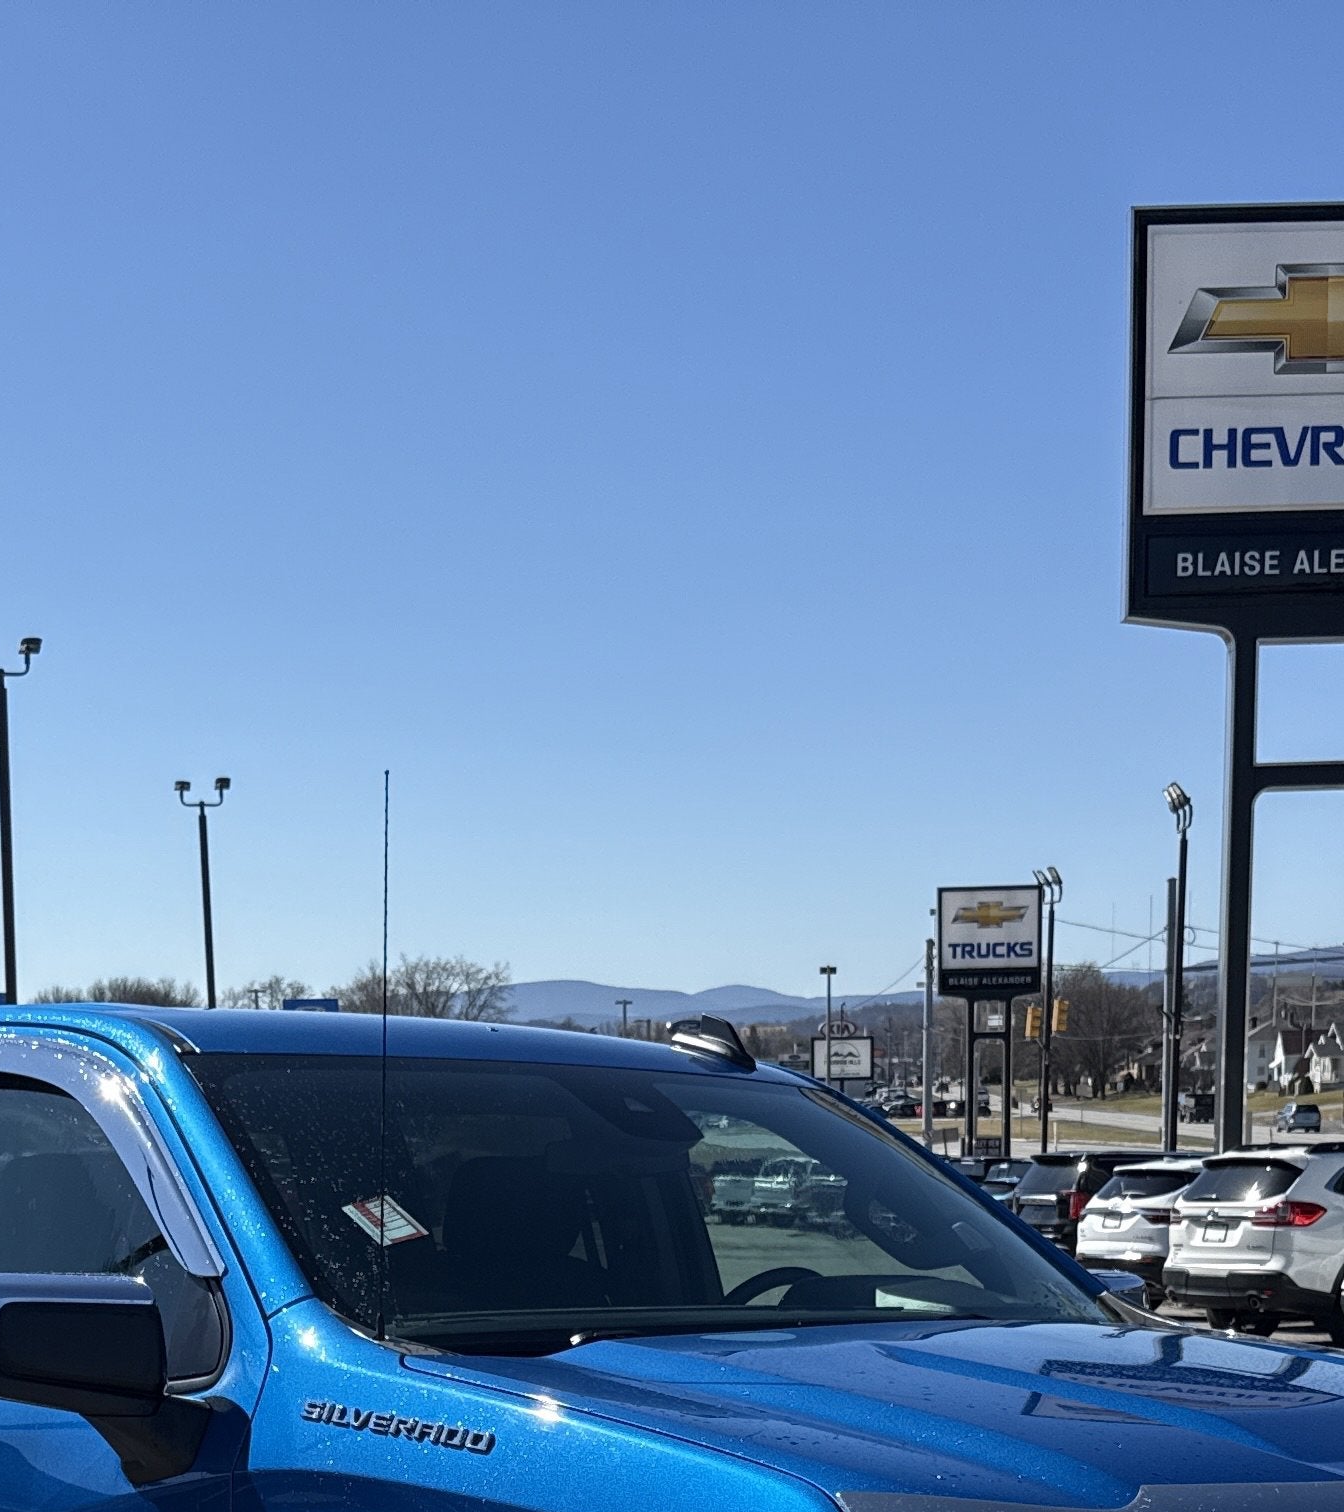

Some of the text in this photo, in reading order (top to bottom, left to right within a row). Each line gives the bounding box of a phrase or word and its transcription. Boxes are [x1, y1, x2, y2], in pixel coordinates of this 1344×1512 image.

[1176, 550, 1280, 577] BLAISE
[948, 942, 1033, 959] TRUCKS
[948, 976, 1033, 986] BLAISE ALEXANDER
[301, 1399, 496, 1455] SILVERADO
